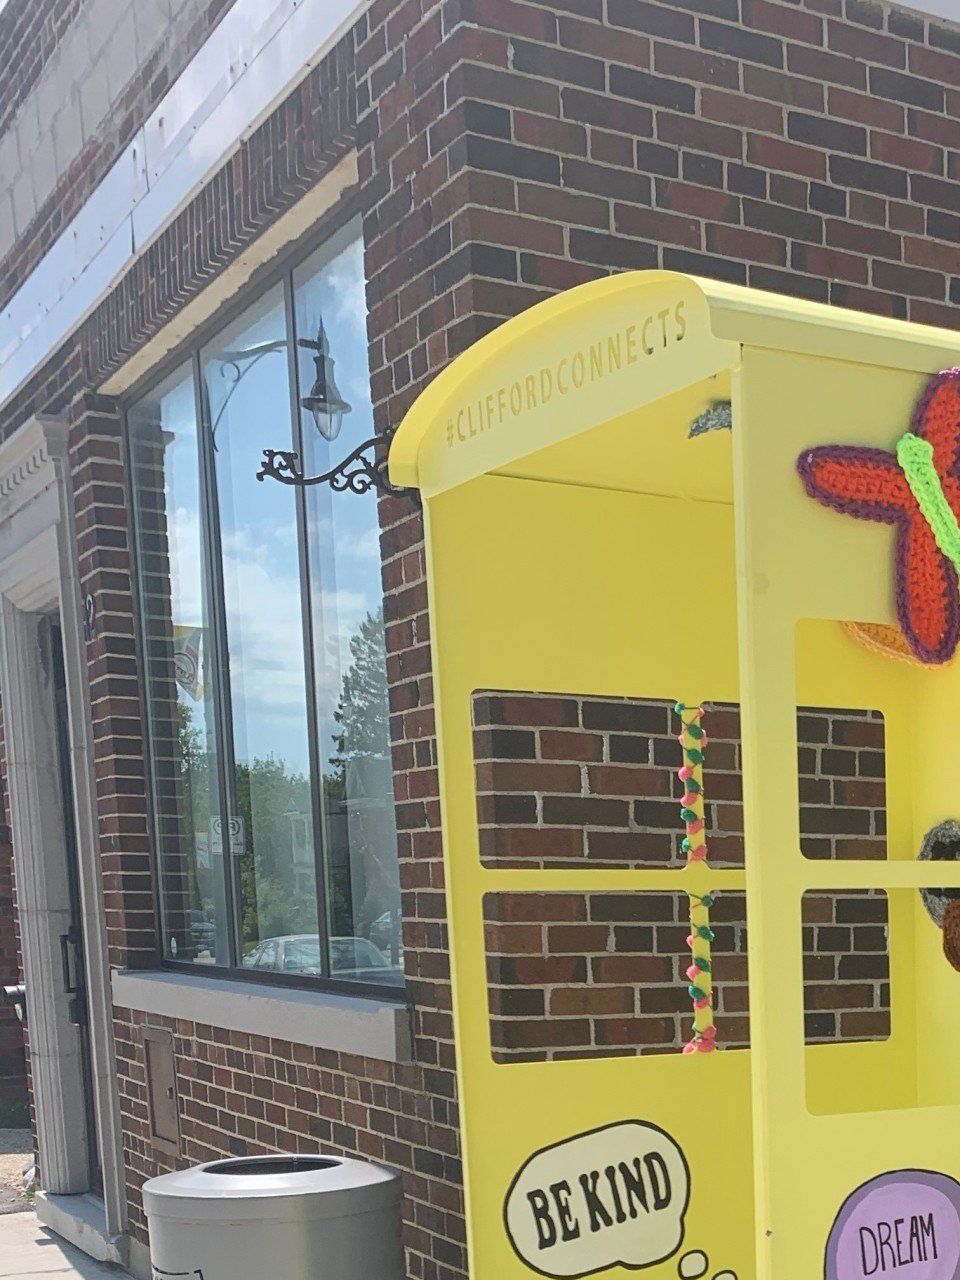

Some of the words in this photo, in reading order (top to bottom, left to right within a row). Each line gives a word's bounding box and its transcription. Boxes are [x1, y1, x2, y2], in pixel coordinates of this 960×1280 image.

[446, 300, 688, 448] #CLIFFORDCONNECTS
[526, 1179, 581, 1251] BE
[578, 1151, 673, 1233] KIND
[858, 1212, 939, 1277] DREAM
